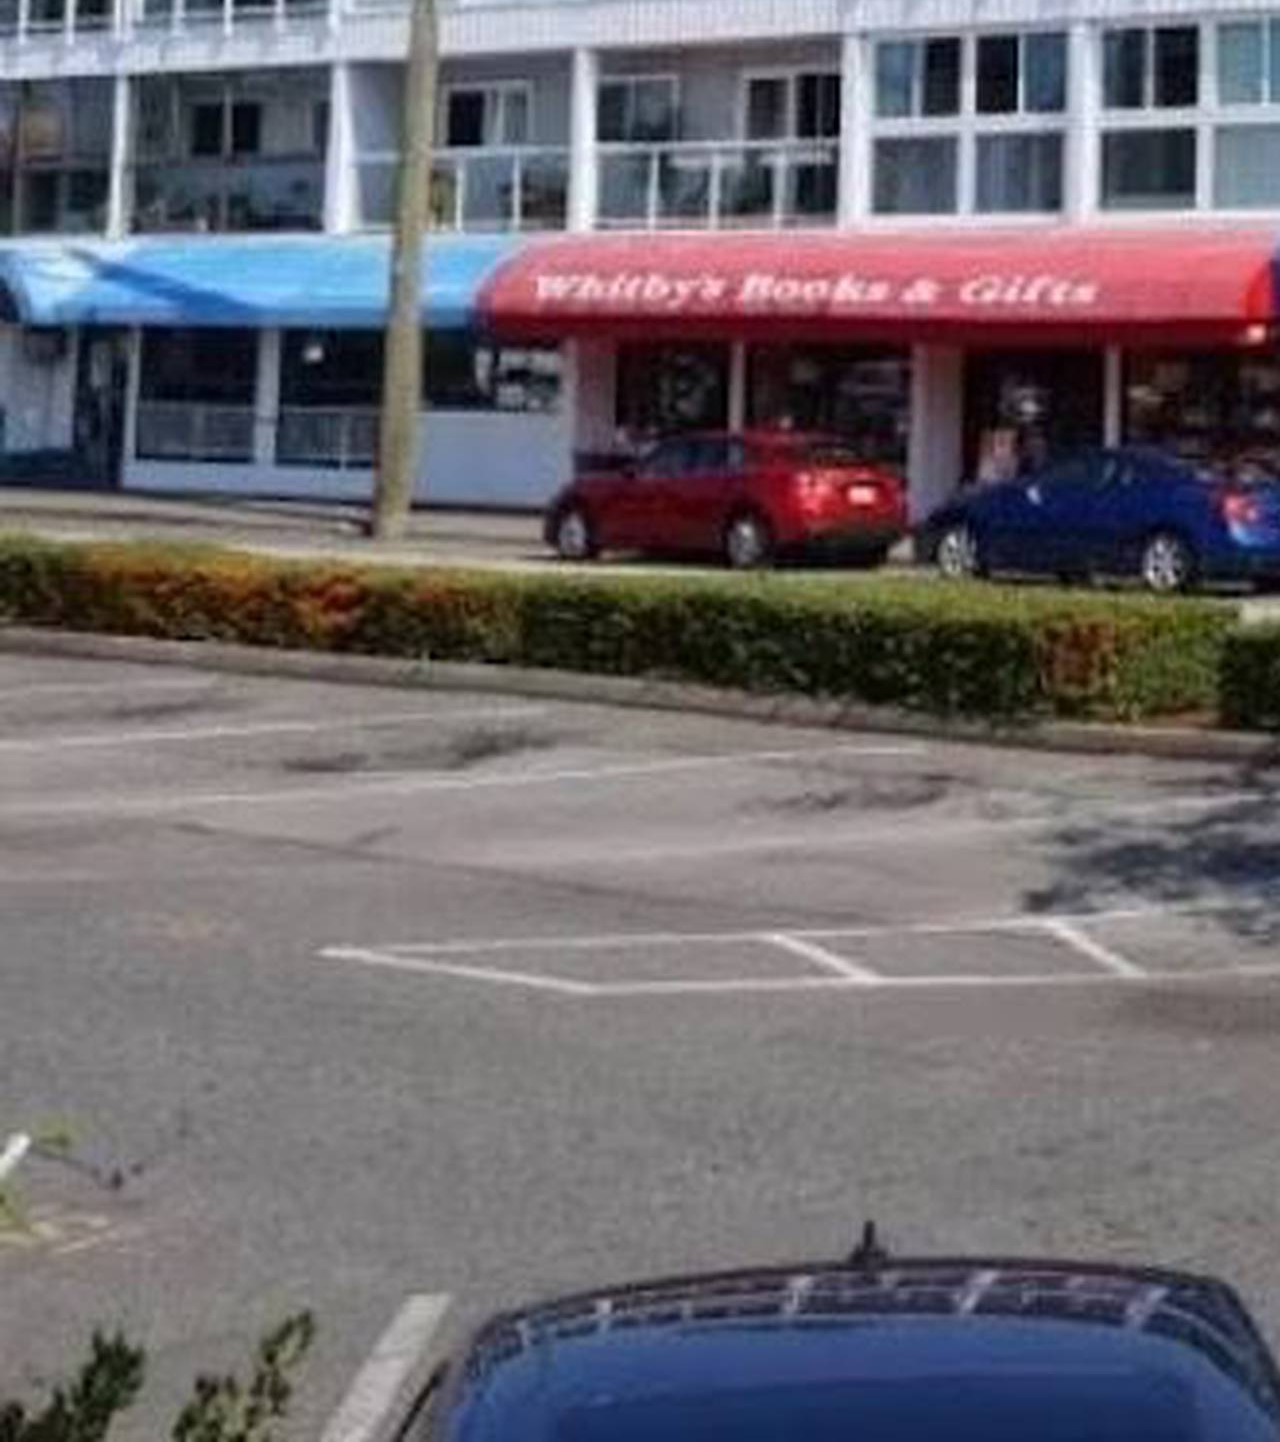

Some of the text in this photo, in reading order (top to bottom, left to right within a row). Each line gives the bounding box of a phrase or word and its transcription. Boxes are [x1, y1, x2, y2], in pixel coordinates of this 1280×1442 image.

[536, 273, 1098, 309] Whitby's Books & Gifts
